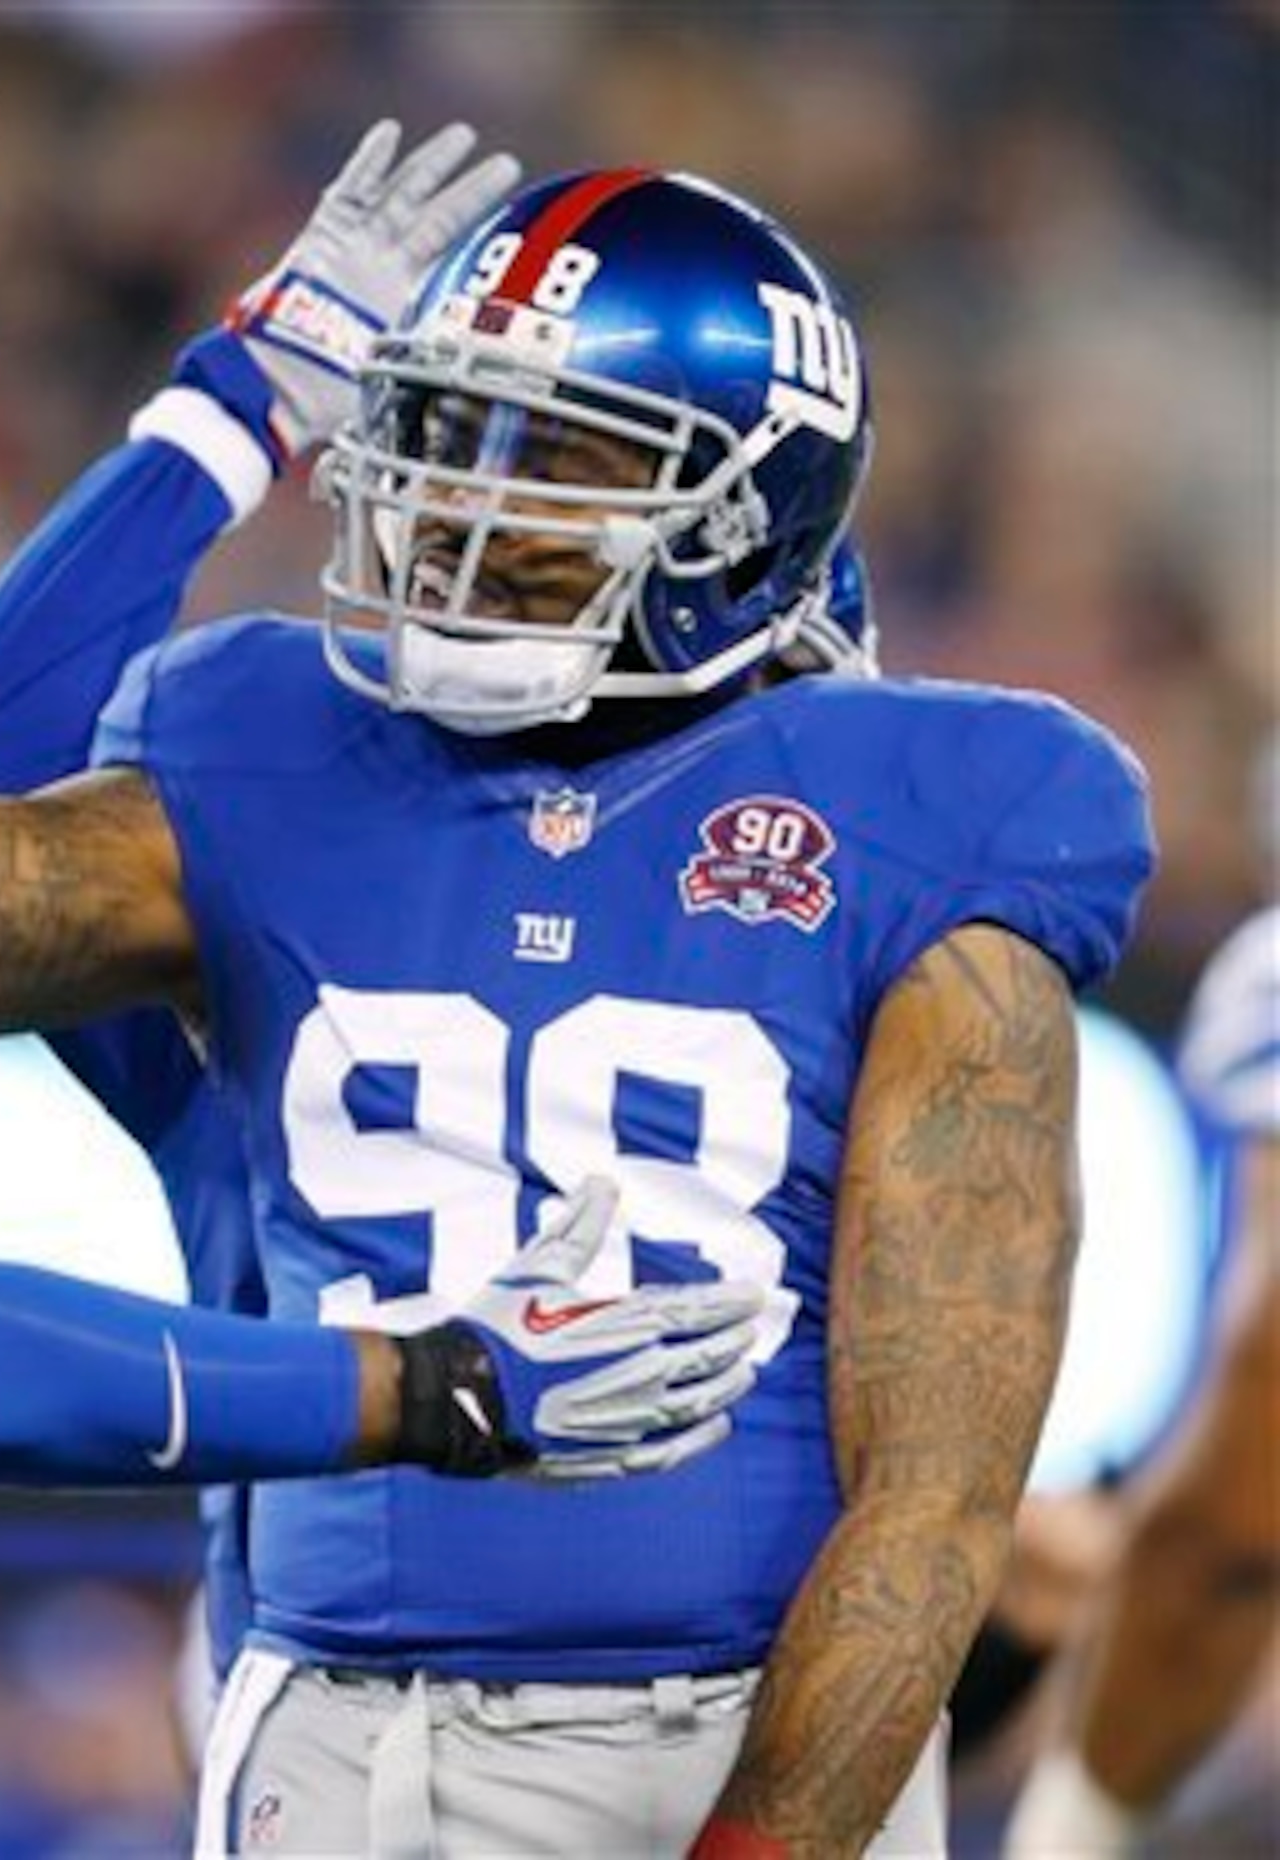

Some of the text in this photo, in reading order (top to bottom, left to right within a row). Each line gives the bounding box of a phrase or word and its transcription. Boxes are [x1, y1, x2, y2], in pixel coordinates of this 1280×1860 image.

[463, 231, 602, 319] 98
[731, 807, 806, 862] 90
[282, 983, 803, 1366] 98
